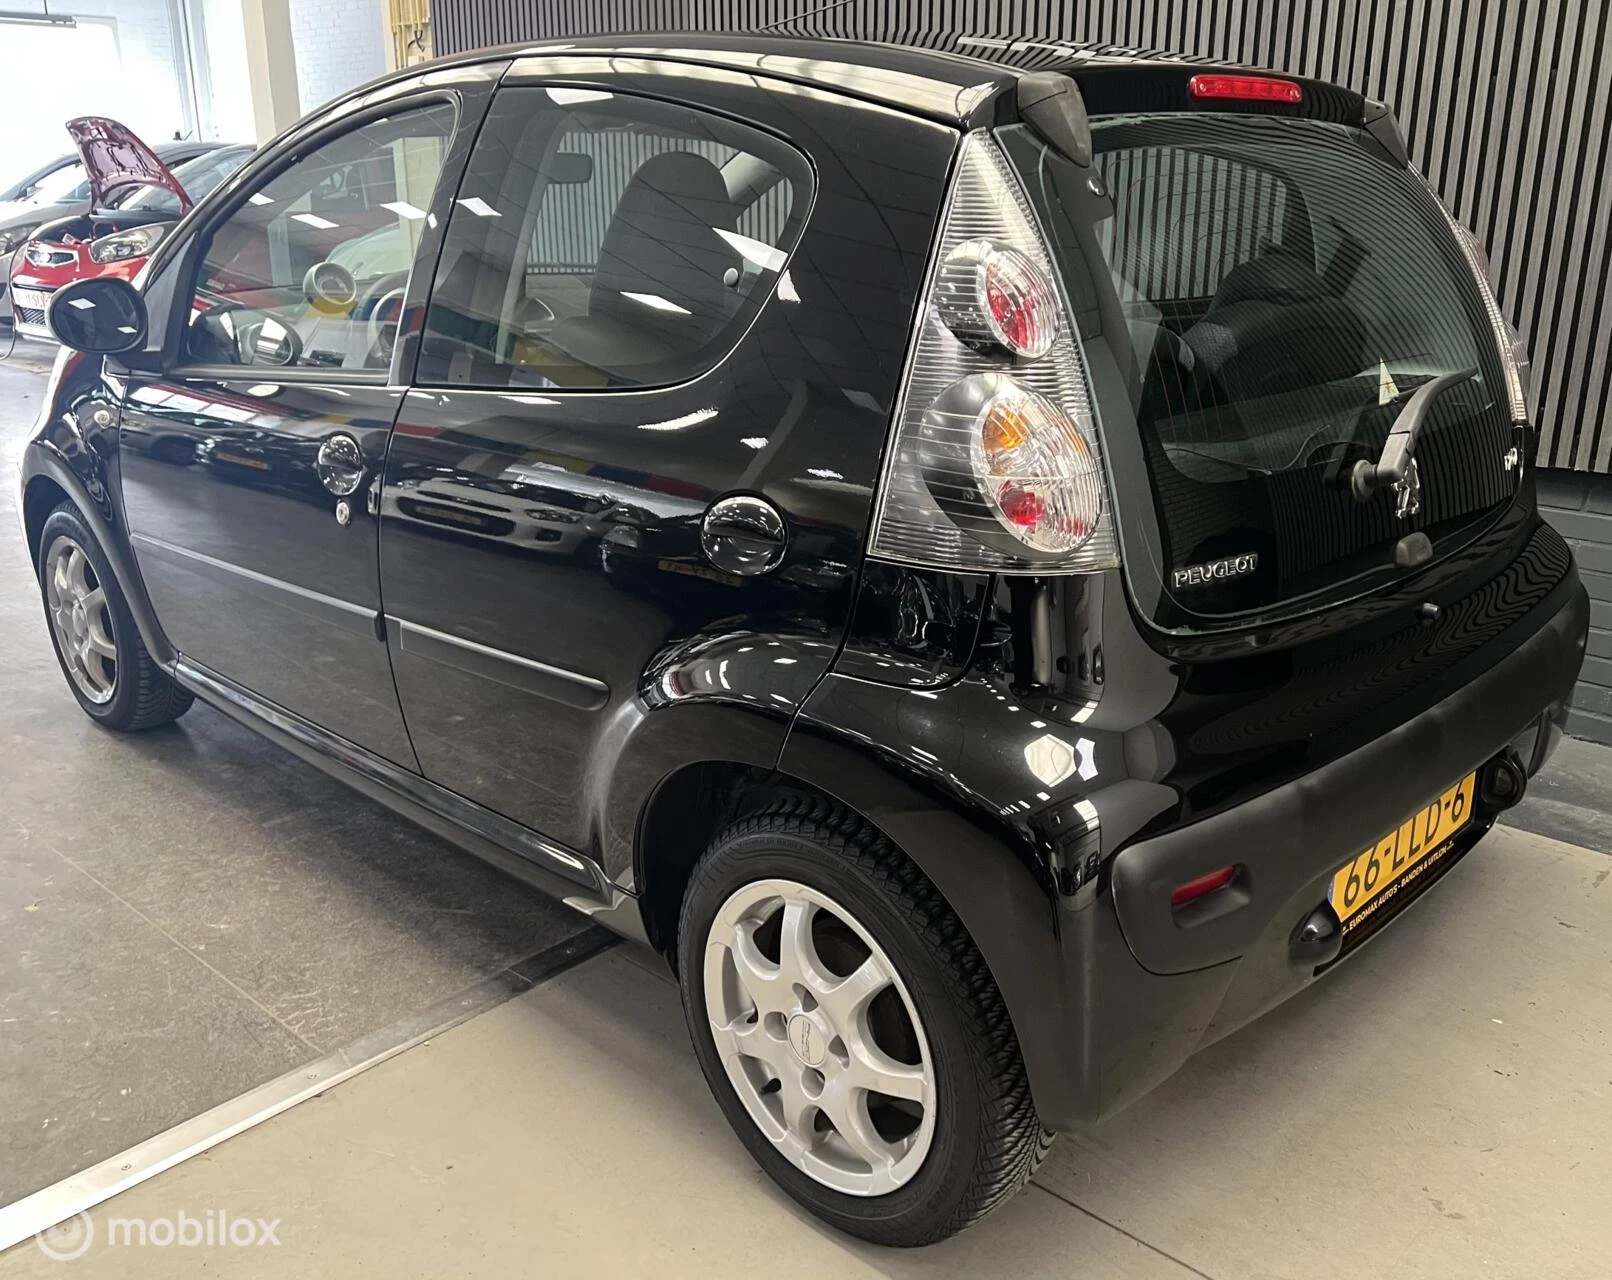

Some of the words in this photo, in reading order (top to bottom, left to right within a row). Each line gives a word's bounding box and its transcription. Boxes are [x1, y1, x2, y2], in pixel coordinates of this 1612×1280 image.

[1173, 553, 1258, 588] PEUGEOT
[1343, 780, 1465, 908] 66-LLD-6
[1349, 900, 1378, 931] EUROMAX
[1377, 883, 1399, 907] AUTOS
[1401, 863, 1424, 888] BANDEN
